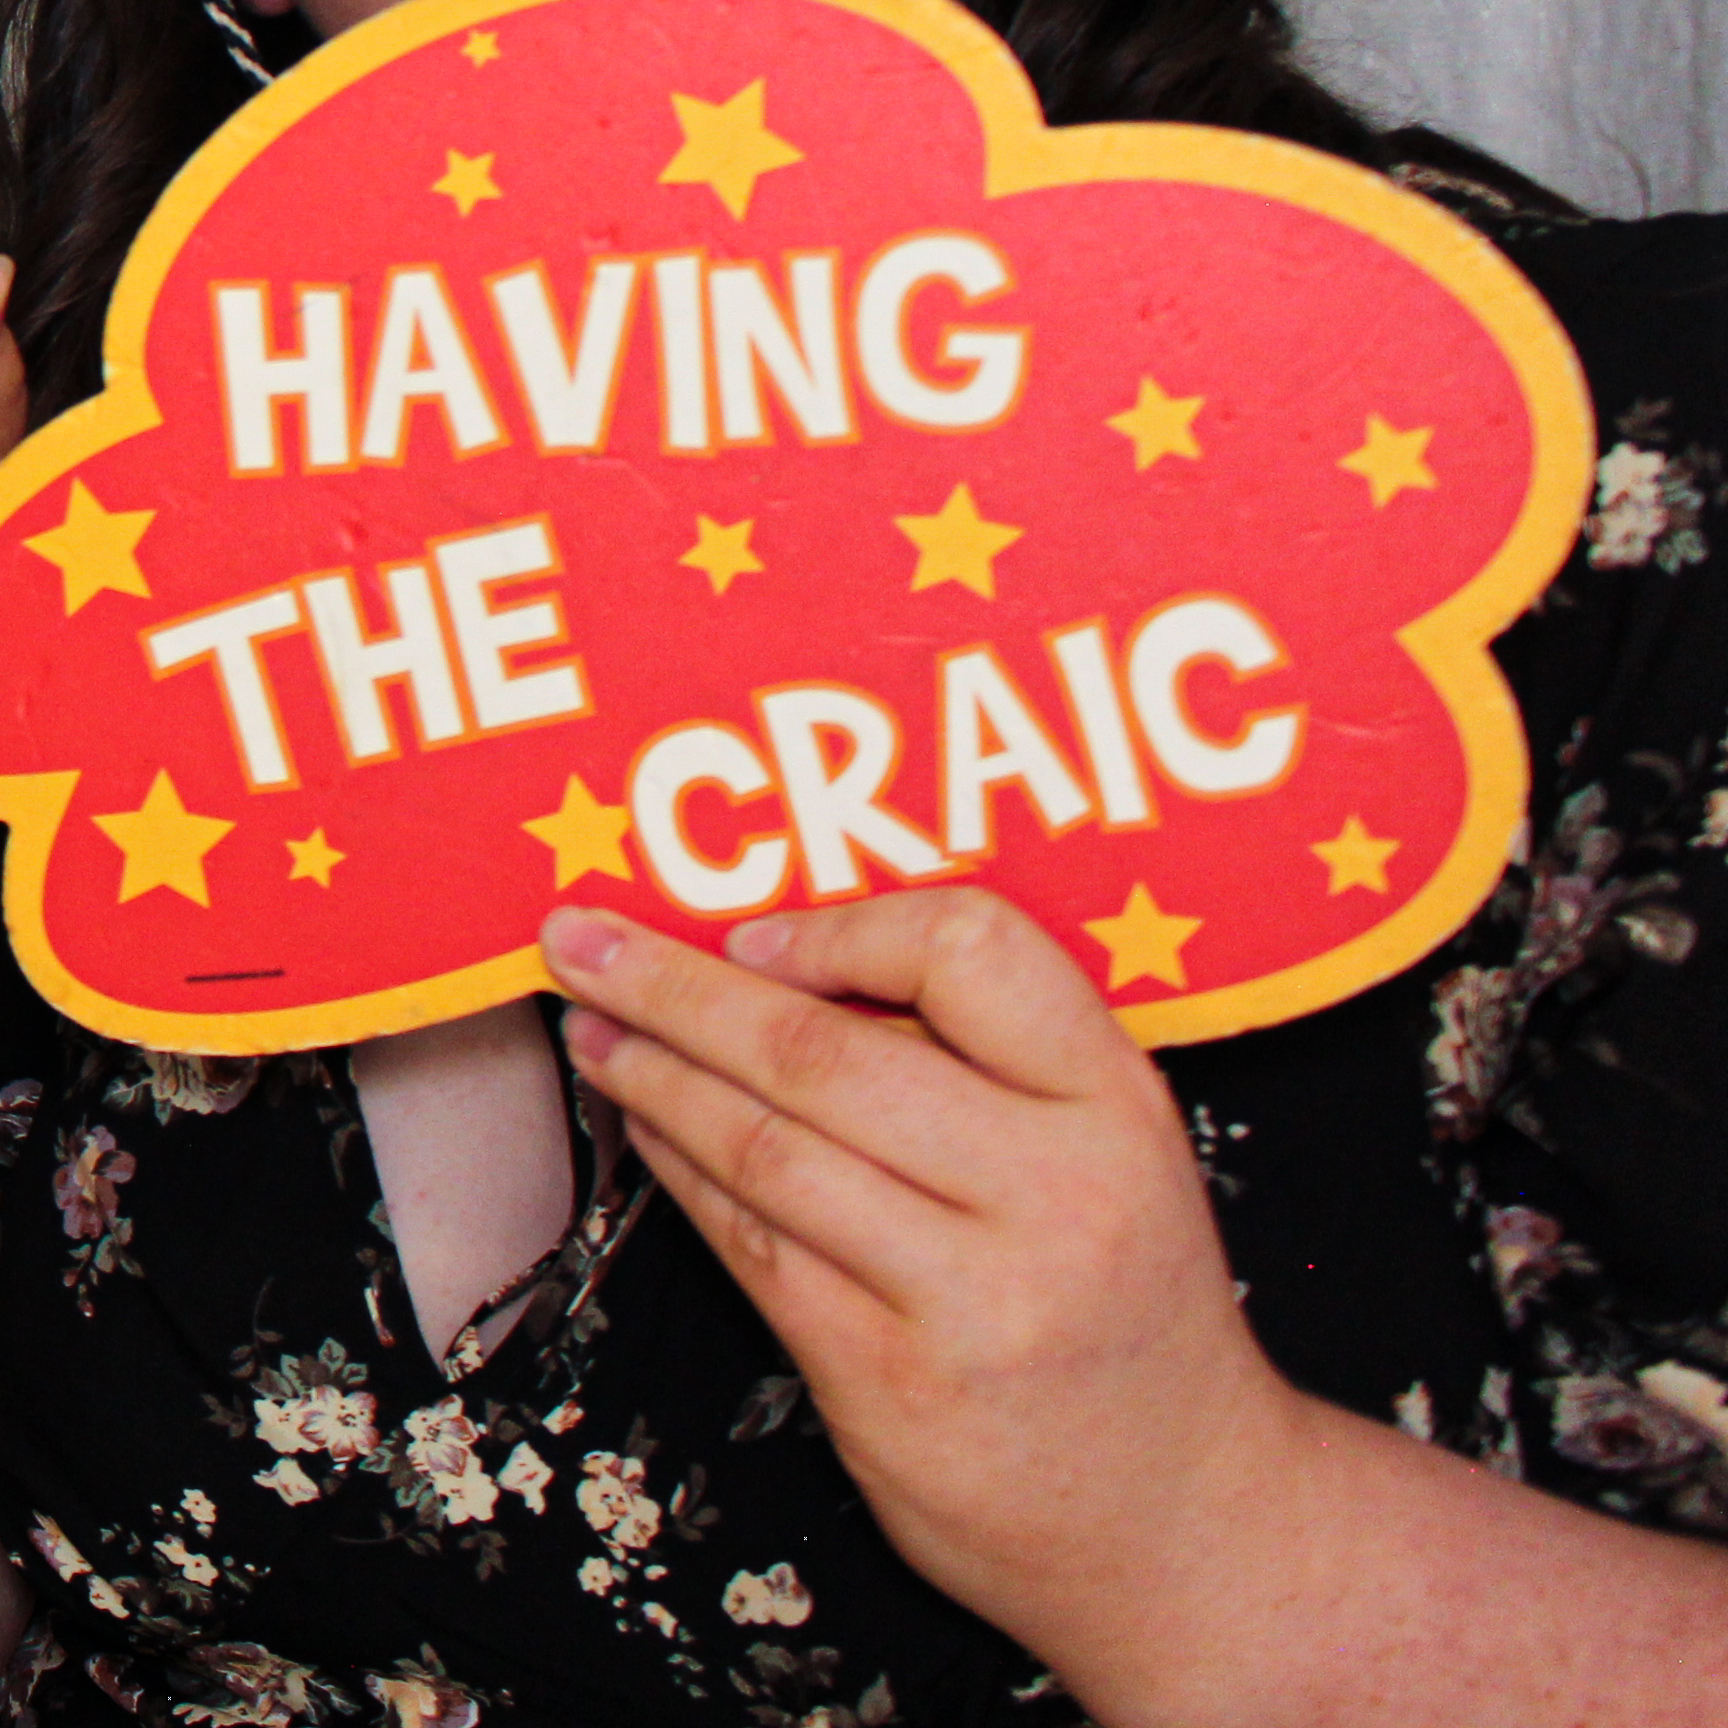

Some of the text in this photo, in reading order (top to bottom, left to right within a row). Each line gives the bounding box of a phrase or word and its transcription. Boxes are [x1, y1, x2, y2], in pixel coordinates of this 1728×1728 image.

[216, 234, 1024, 471] HAVING
[148, 522, 584, 785] THE
[632, 598, 1298, 912] CRAIC
